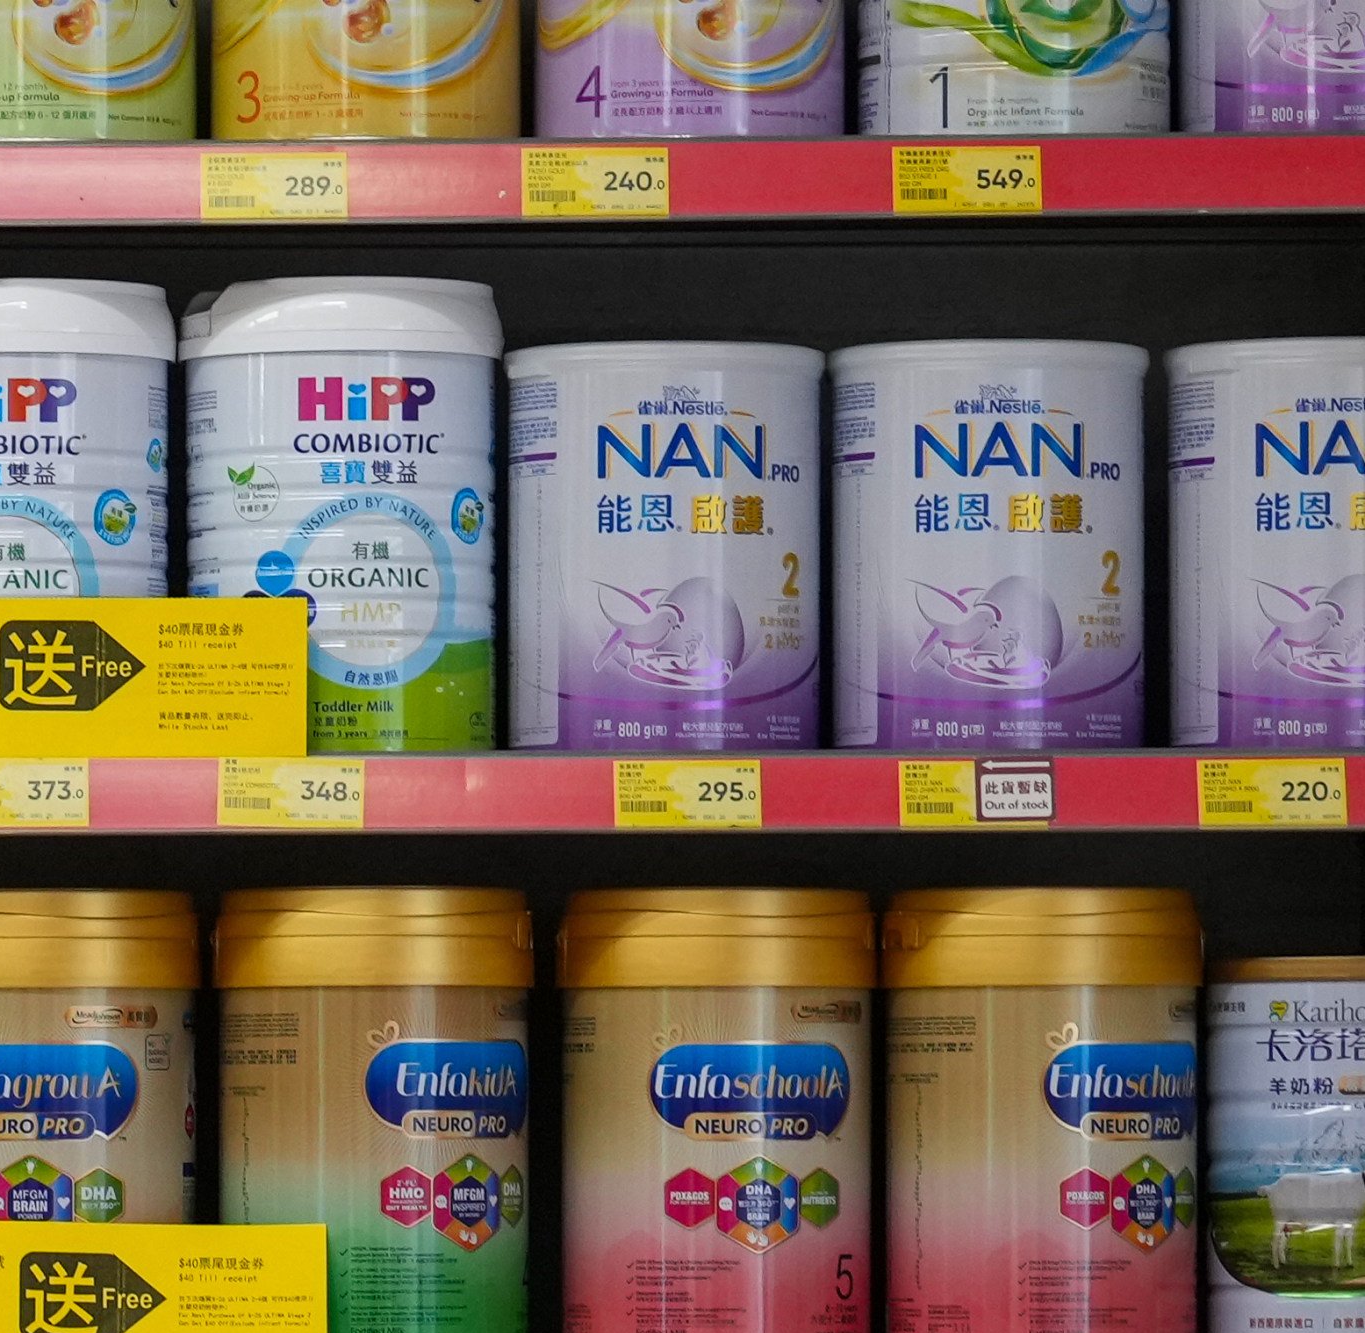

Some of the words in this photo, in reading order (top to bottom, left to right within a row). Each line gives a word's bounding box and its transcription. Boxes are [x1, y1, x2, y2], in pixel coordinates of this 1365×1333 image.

[236, 70, 262, 124] 3
[574, 65, 607, 119] 4
[928, 66, 950, 129] 1
[967, 107, 1008, 119] Organic
[1011, 106, 1042, 117] Infant
[1044, 107, 1085, 117] Formula
[297, 376, 436, 423] HiPP
[597, 421, 768, 480] NAN
[772, 462, 800, 483] PRO
[915, 420, 1084, 479] NAN
[1090, 462, 1120, 482] PRO
[1255, 492, 1333, 532] 能恩
[307, 566, 430, 590] ORGANIC
[781, 551, 801, 597] 2
[5, 629, 76, 706] 送
[81, 656, 133, 678] Free
[1278, 719, 1301, 735] 800
[28, 780, 84, 800] 373.0
[301, 781, 360, 801] 348.0
[698, 781, 756, 802] 295.0
[984, 780, 1049, 796] 此貨暫缺
[1281, 782, 1341, 802] 220.0
[984, 800, 1001, 811] Out
[1006, 799, 1018, 811] of
[1020, 800, 1049, 811] stock
[1269, 1077, 1334, 1096] 羊奶粉
[42, 1117, 85, 1135] PRO
[412, 1116, 473, 1133] NEURO
[479, 1115, 506, 1133] PRO
[695, 1119, 761, 1135] NEURO
[770, 1118, 809, 1136] PRO
[1090, 1119, 1149, 1135] NEURO
[1154, 1118, 1180, 1135] PRO
[836, 1253, 853, 1301] 5
[102, 1287, 153, 1309] Free
